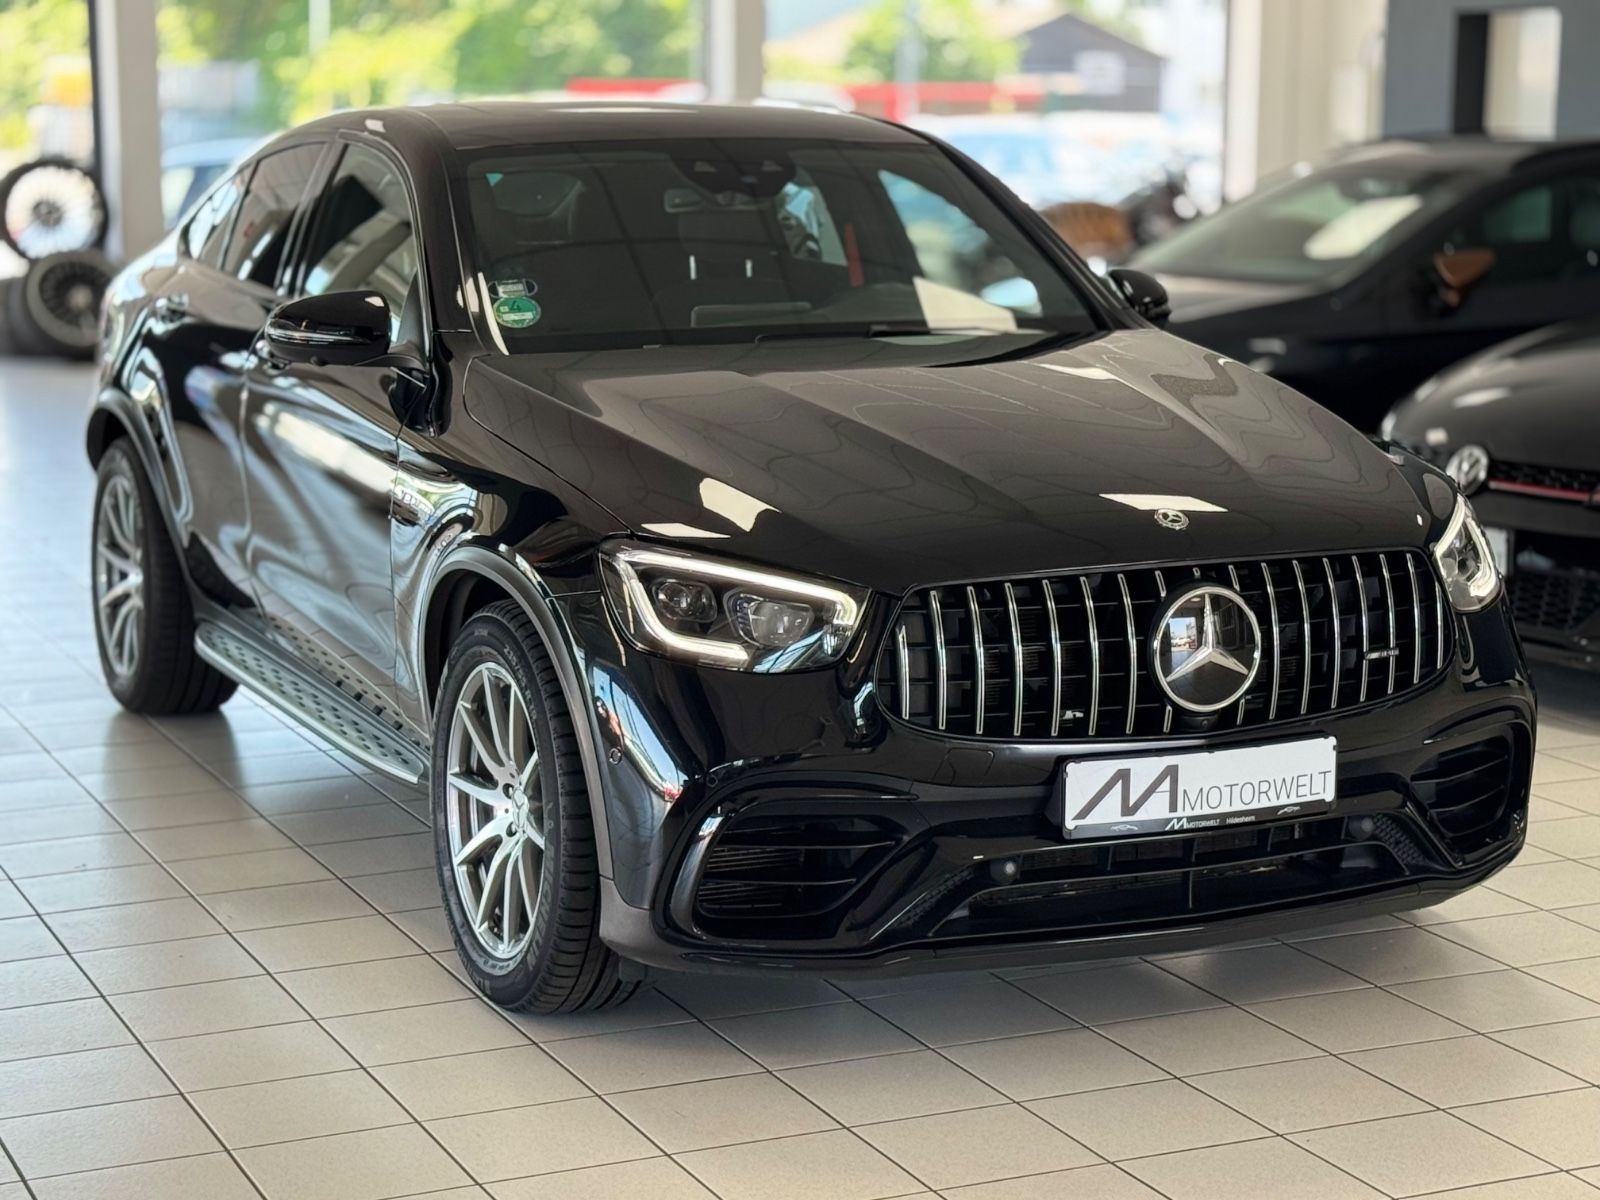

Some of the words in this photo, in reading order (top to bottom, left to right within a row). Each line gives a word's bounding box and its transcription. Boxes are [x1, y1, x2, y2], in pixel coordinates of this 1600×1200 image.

[510, 300, 522, 312] 4
[1182, 770, 1332, 813] MOTORWELT
[525, 843, 555, 973] MICHELIN
